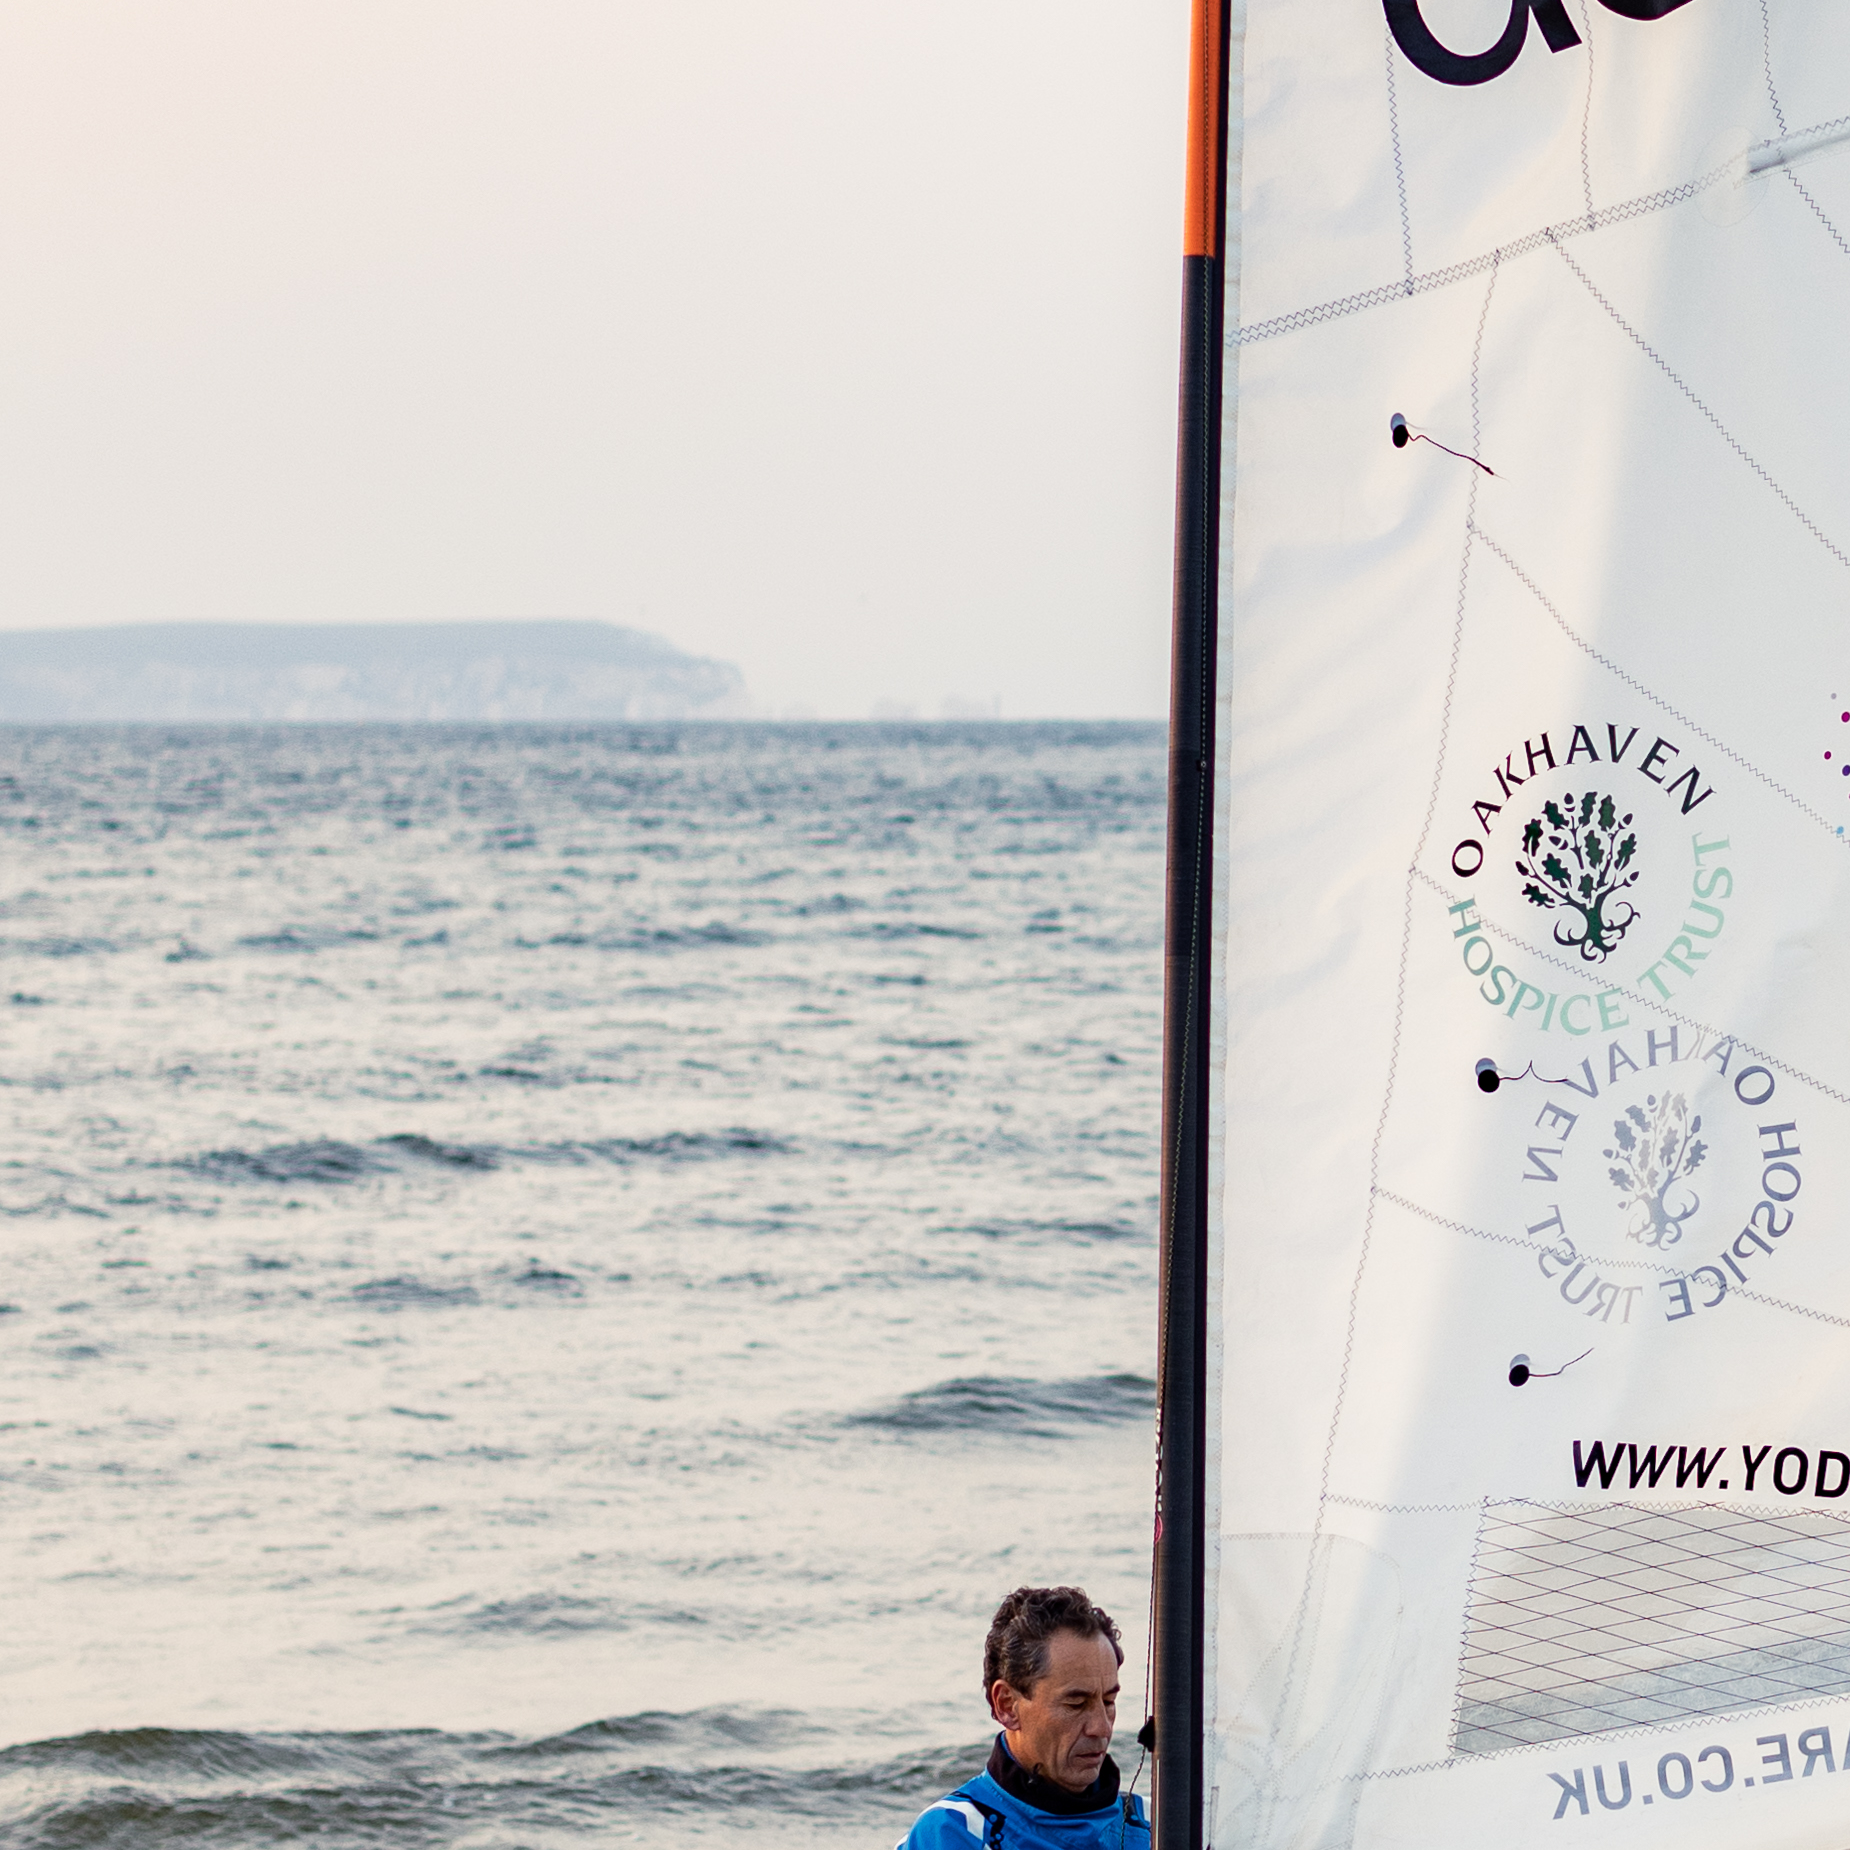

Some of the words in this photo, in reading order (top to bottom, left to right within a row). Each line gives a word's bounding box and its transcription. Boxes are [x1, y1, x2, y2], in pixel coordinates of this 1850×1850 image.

[1451, 722, 1717, 879] OAKHAVEN
[1447, 897, 1630, 1037] HOSPICE
[1636, 830, 1733, 1005] TRUST
